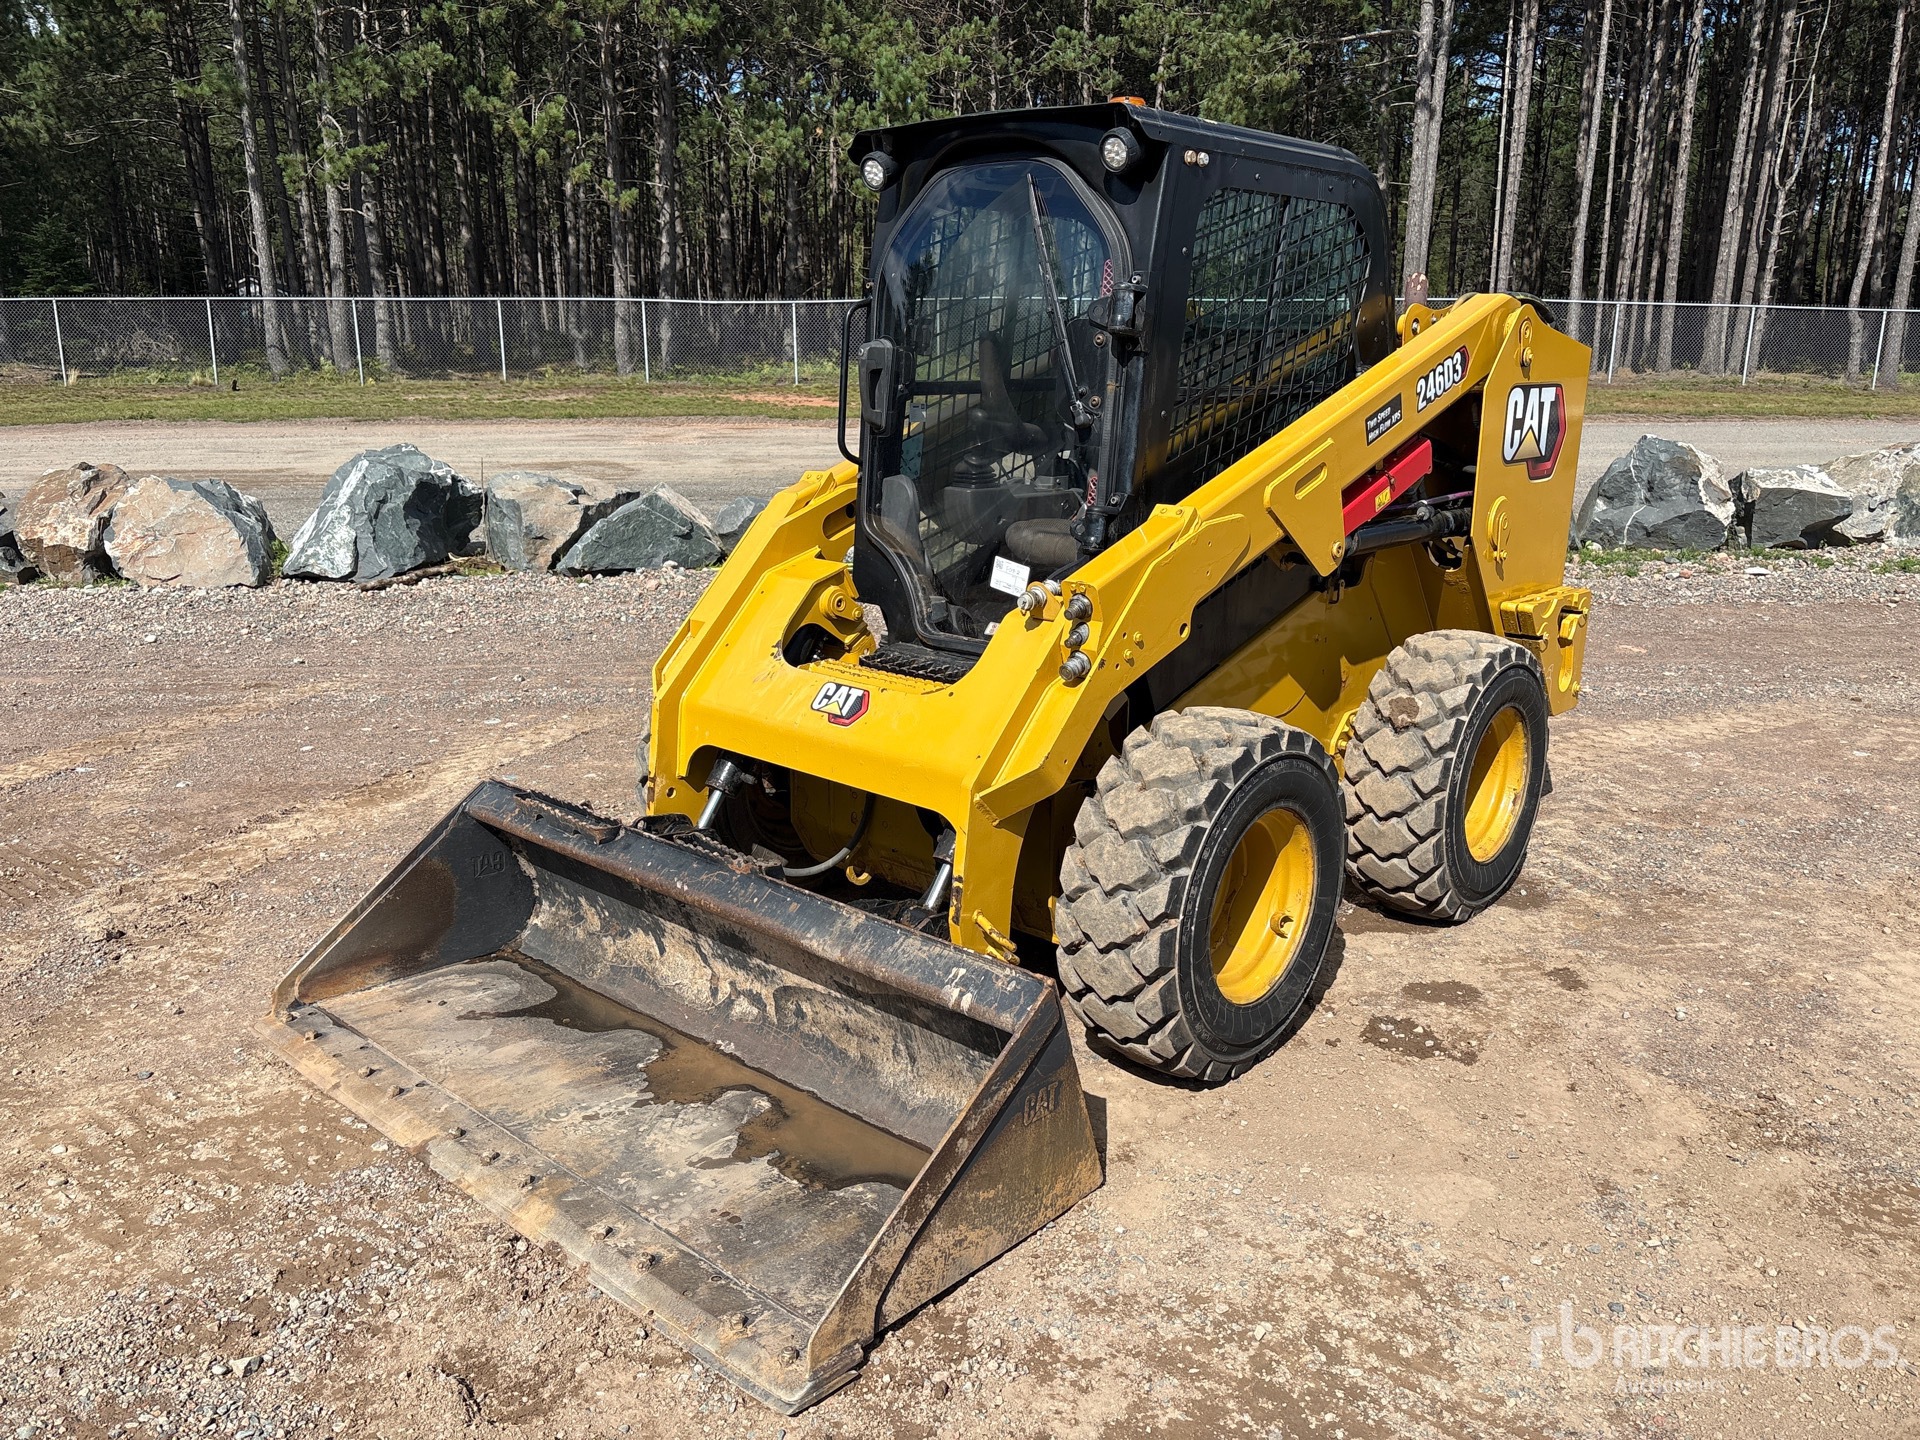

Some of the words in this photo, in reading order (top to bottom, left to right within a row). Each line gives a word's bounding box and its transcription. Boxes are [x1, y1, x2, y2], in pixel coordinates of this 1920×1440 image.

[1416, 351, 1462, 411] 246D3
[1503, 386, 1556, 461] CAT
[811, 682, 865, 717] CAT
[1023, 1081, 1058, 1125] CAT
